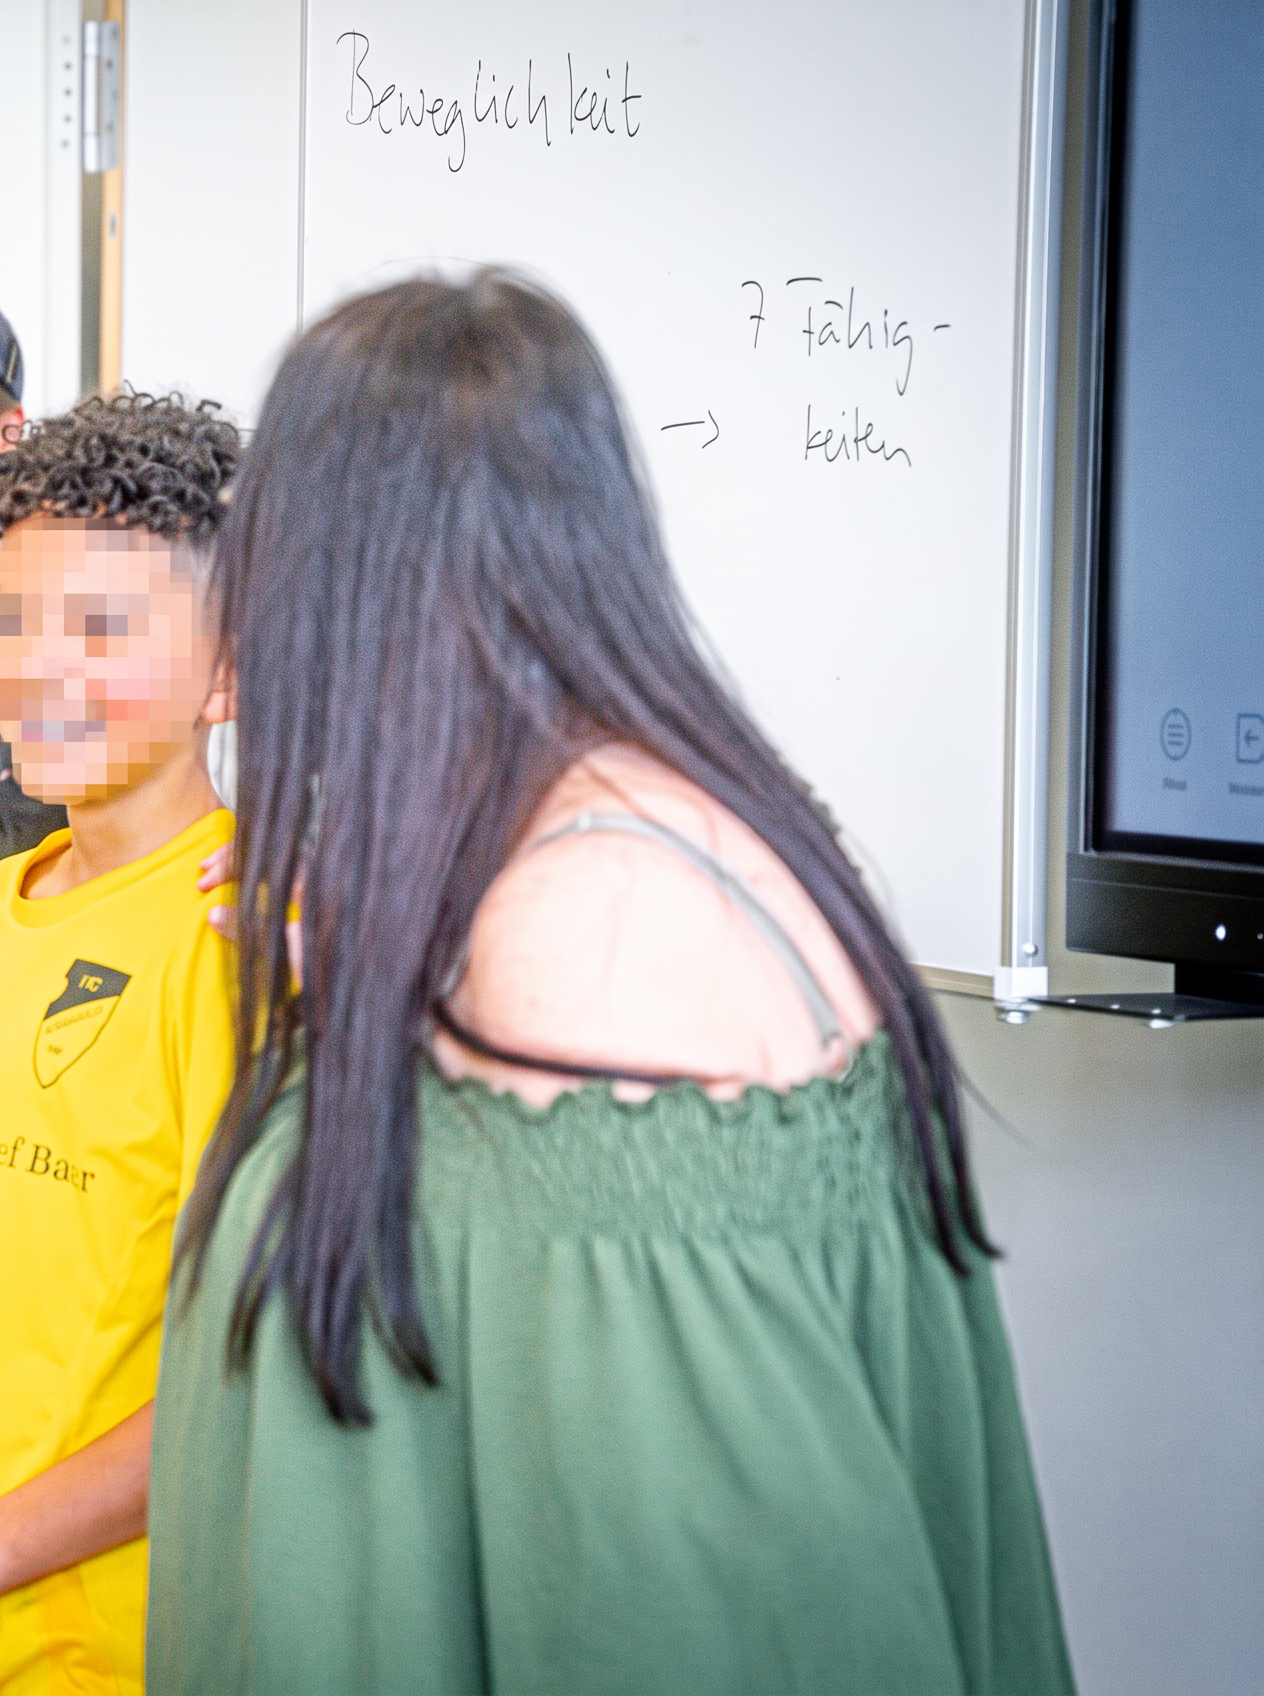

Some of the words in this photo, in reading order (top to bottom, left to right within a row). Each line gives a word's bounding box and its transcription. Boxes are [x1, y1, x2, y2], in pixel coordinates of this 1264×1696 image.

[336, 29, 642, 172] Beweglichkeit
[741, 280, 766, 349] 7
[804, 403, 912, 467] keiten
